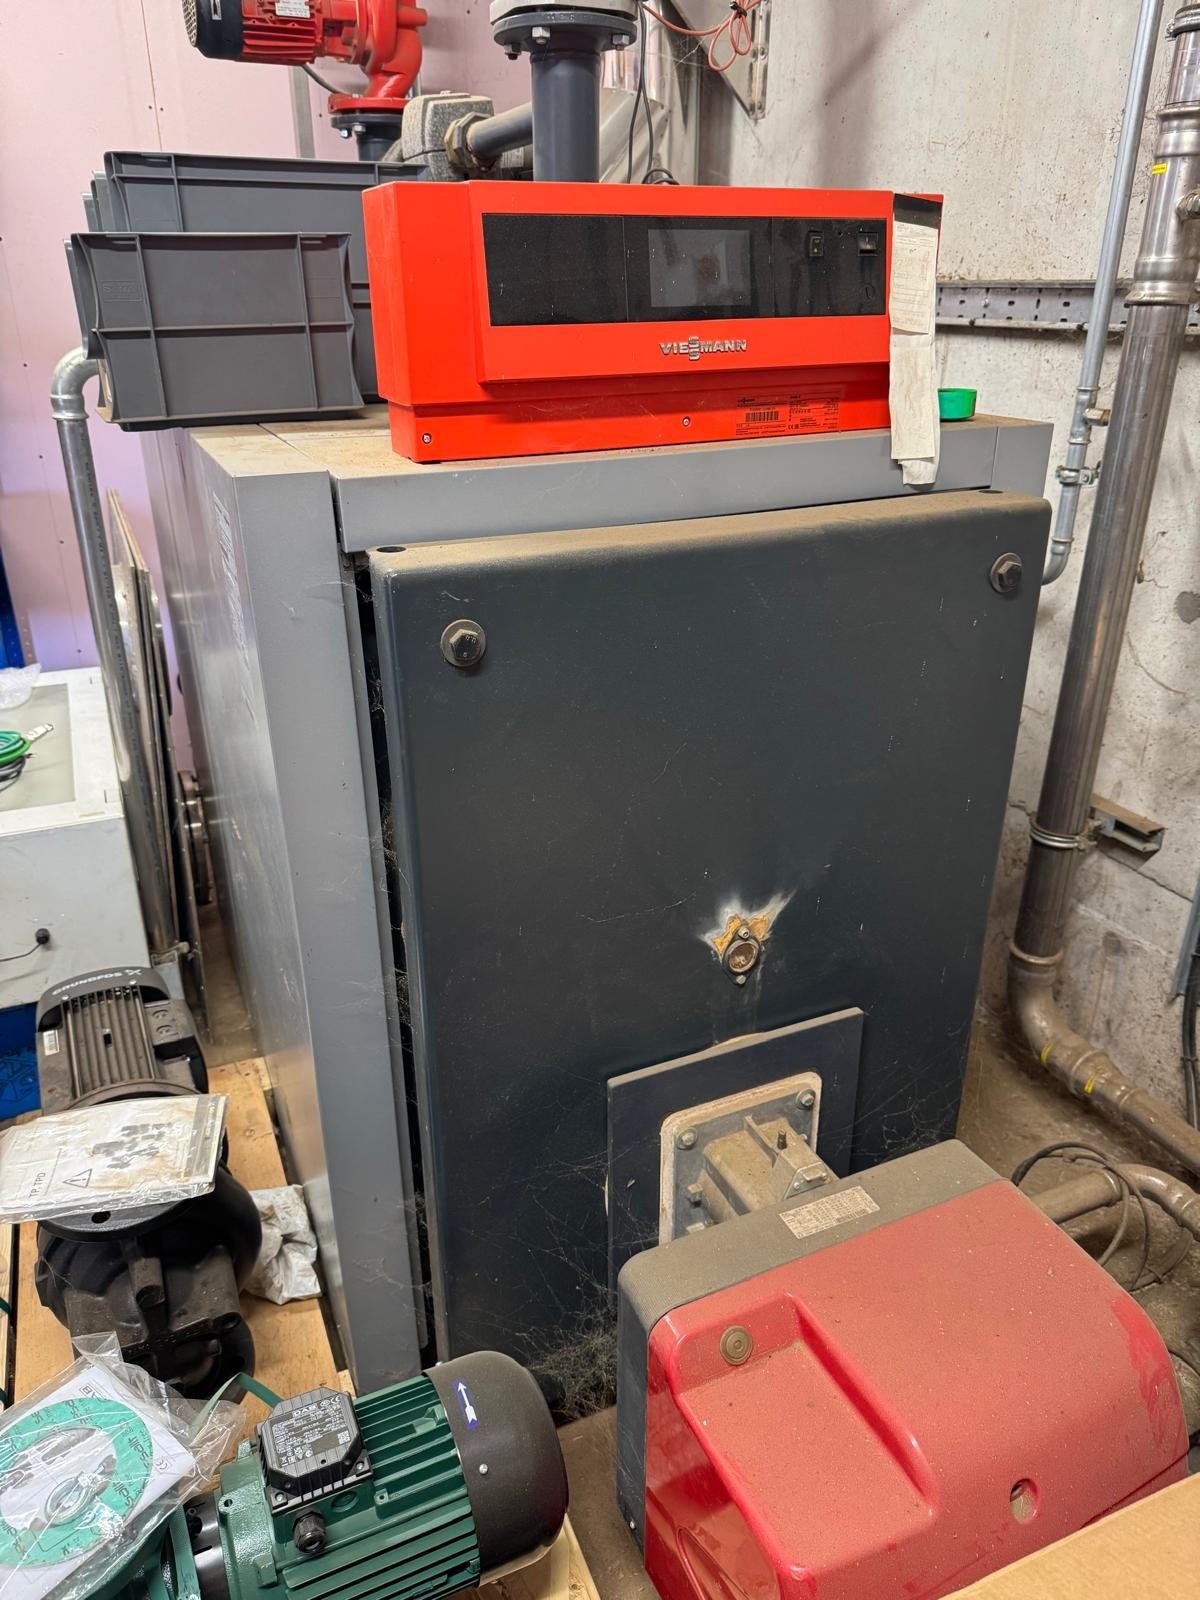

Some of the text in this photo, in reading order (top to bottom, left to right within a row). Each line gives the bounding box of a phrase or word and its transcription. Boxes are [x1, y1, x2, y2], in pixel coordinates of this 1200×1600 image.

[659, 336, 747, 361] VIESSMANN
[52, 972, 122, 995] GRUNDFOS
[293, 1404, 317, 1417] DAB
